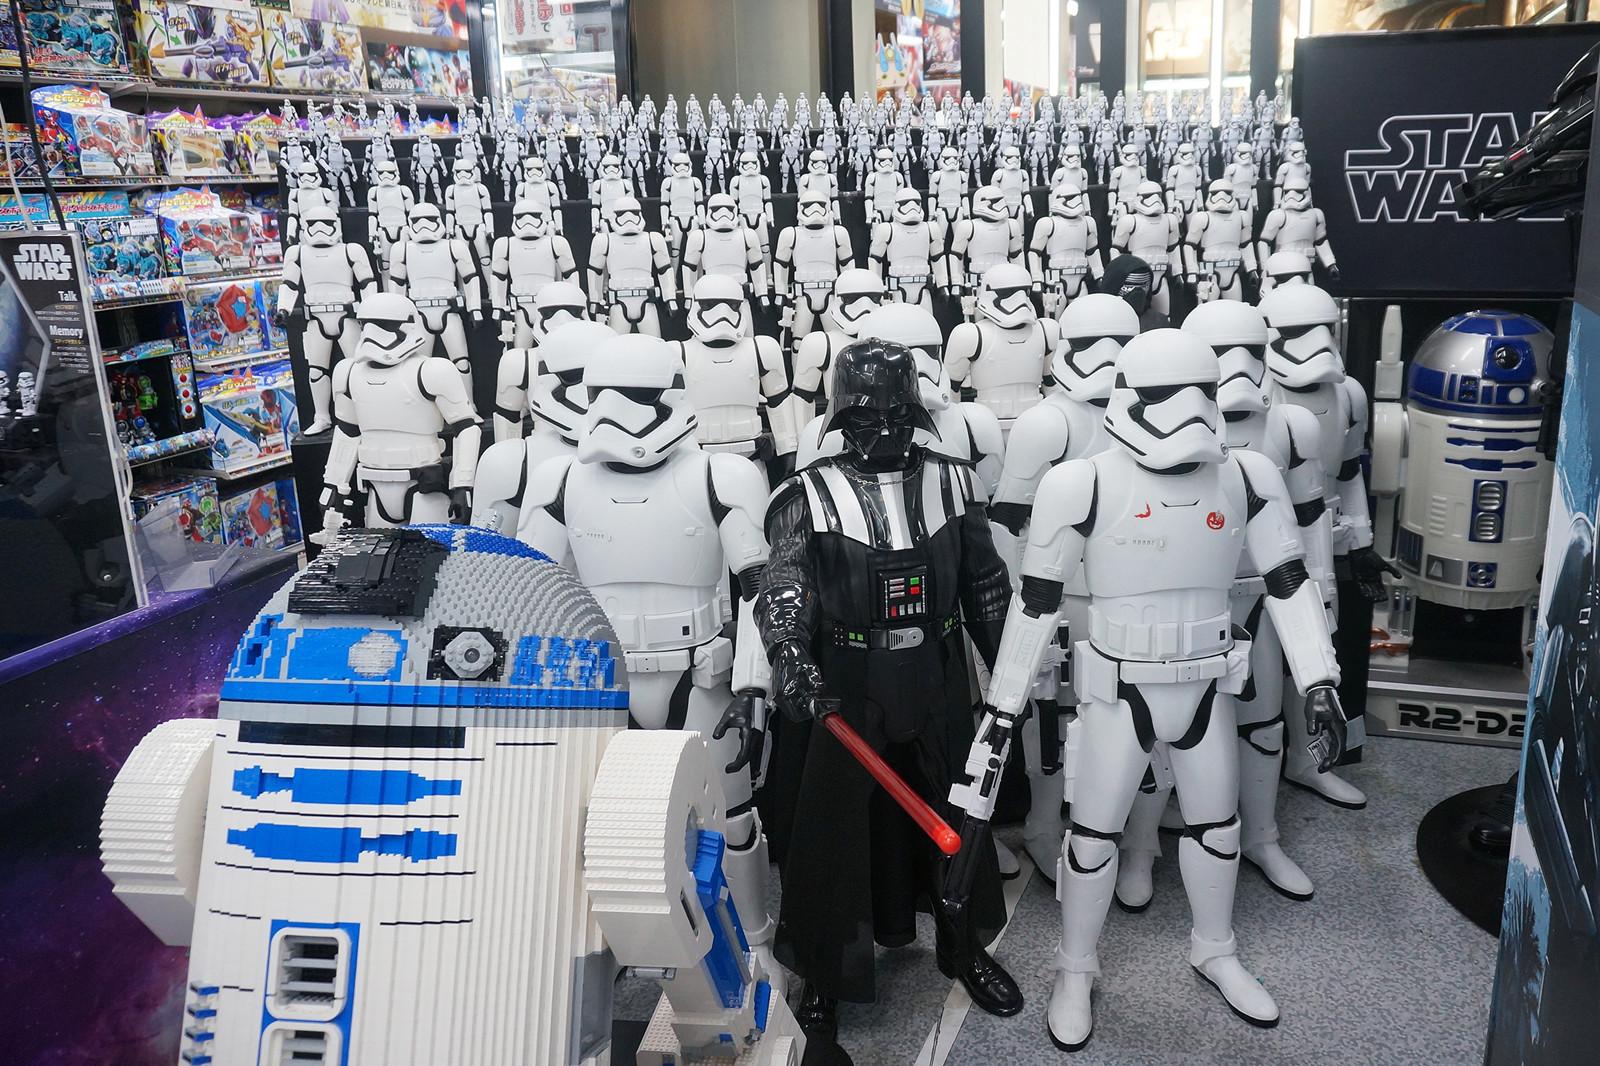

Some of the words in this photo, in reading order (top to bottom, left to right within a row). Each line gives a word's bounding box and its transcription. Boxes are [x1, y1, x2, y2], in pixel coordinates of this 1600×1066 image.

[1344, 112, 1552, 170] STA
[13, 243, 71, 262] STAR
[14, 262, 73, 281] WARS
[58, 290, 78, 302] Talk
[49, 325, 84, 339] Memory
